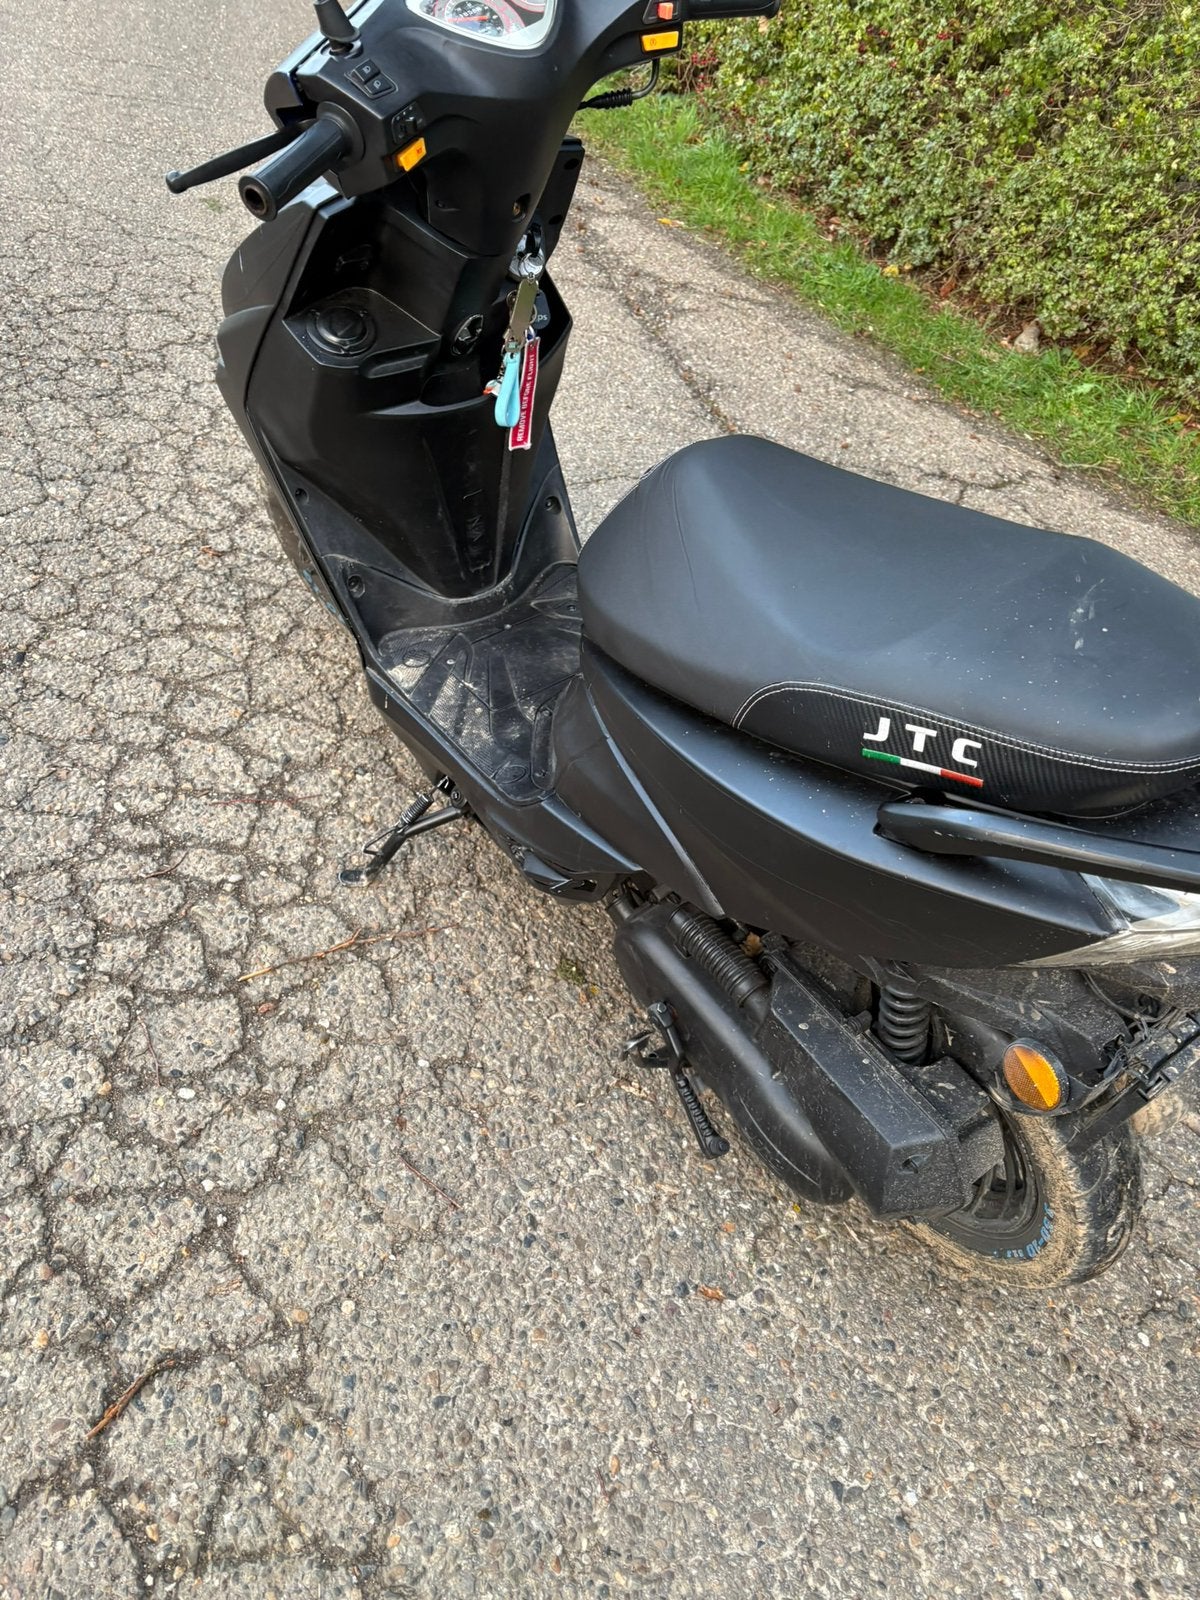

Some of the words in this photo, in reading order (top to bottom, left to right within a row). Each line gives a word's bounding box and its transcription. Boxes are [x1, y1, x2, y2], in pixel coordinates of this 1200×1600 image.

[516, 410, 526, 442] REMOVE
[521, 383, 531, 409] BEFORE
[527, 354, 535, 380] FLIGHT
[863, 717, 982, 768] JTC
